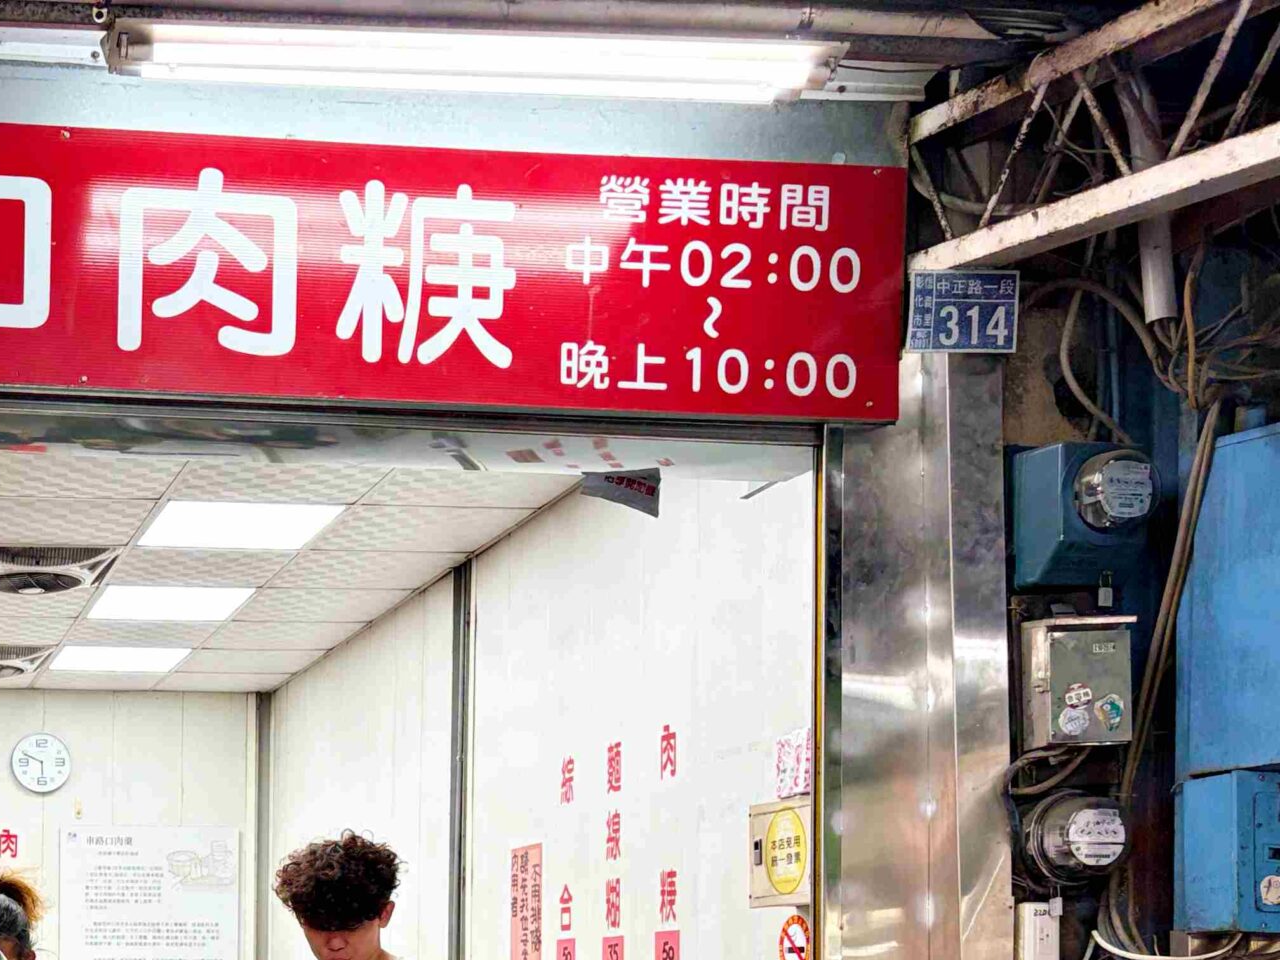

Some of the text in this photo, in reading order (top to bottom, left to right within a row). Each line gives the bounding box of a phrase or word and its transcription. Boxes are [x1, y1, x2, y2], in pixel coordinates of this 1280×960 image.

[597, 172, 831, 233] 營業時間
[564, 239, 862, 296] 中午02:00
[936, 278, 1016, 296] 中正路一段
[938, 305, 1009, 346] 314
[559, 341, 858, 398] 晚上10:00
[18, 757, 30, 768] 9
[35, 738, 49, 749] 12
[54, 757, 66, 768] 3
[559, 755, 576, 932] 綜合
[605, 740, 623, 931] 麵線糊
[770, 835, 801, 850] 本店免用
